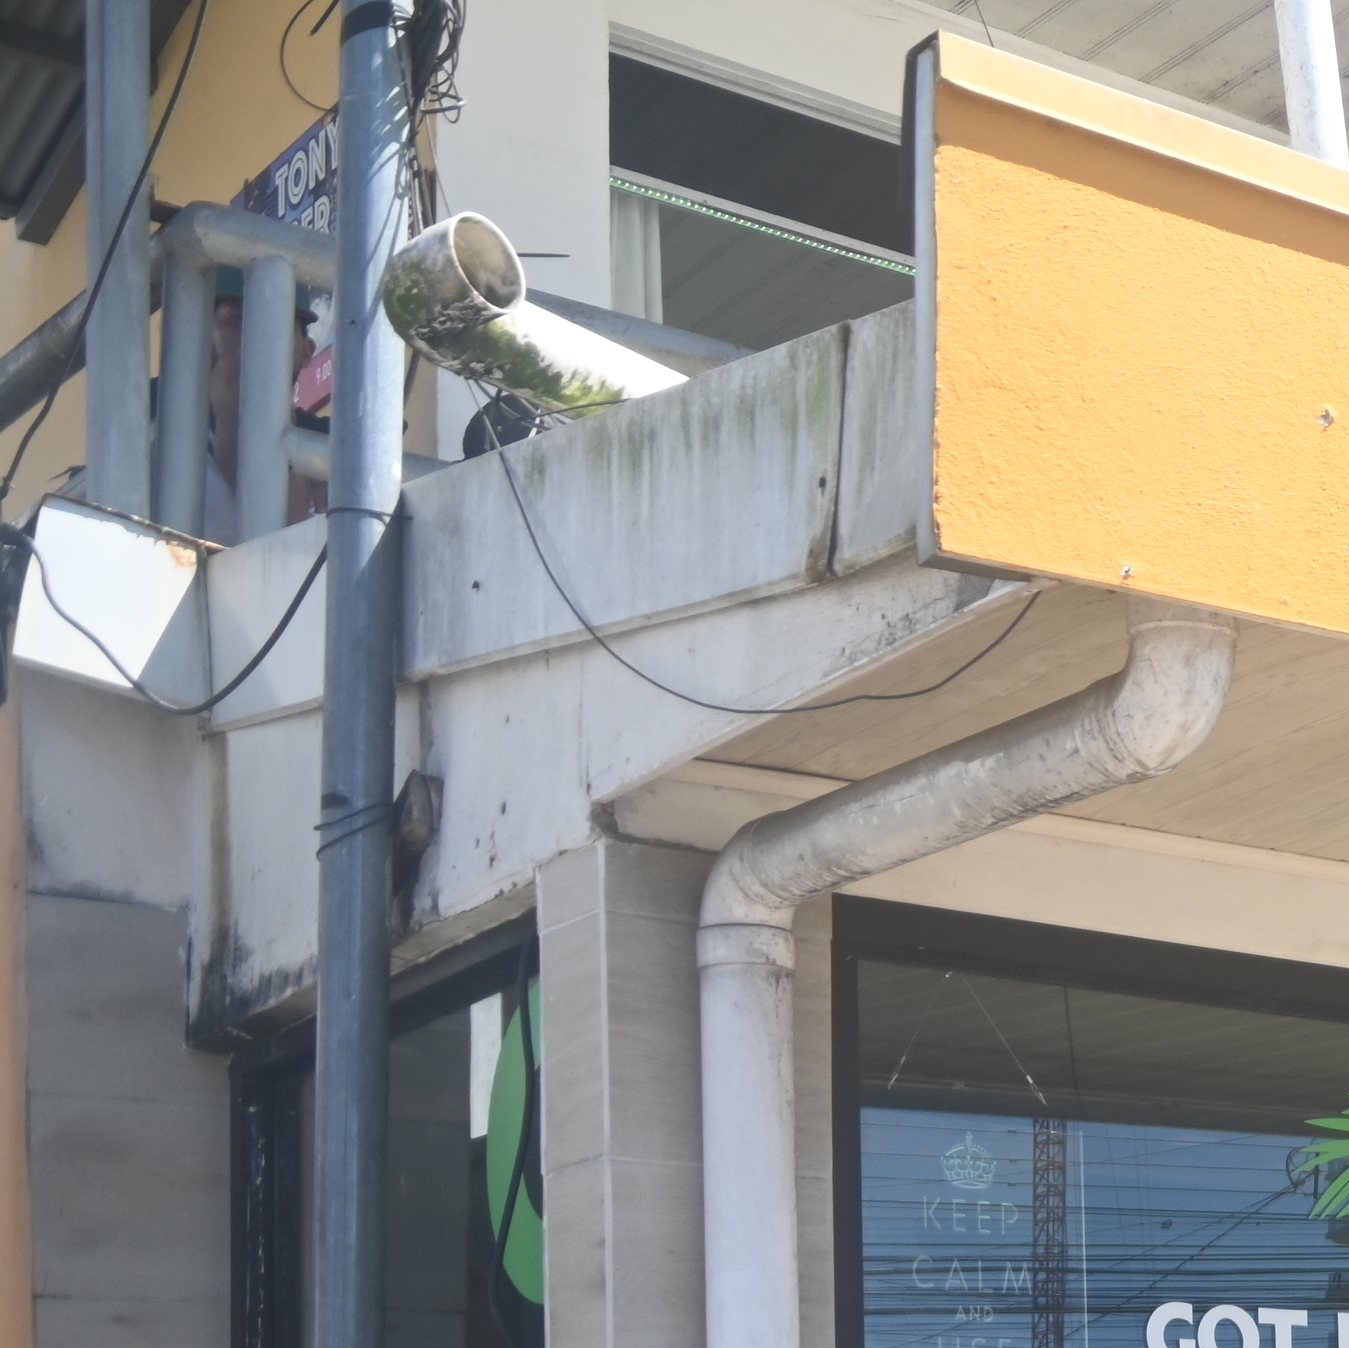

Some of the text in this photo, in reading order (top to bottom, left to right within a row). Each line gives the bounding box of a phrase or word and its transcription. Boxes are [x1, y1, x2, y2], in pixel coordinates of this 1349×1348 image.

[923, 1195, 1019, 1235] KEEP
[912, 1255, 1033, 1295] CALM
[955, 1305, 1004, 1322] AND
